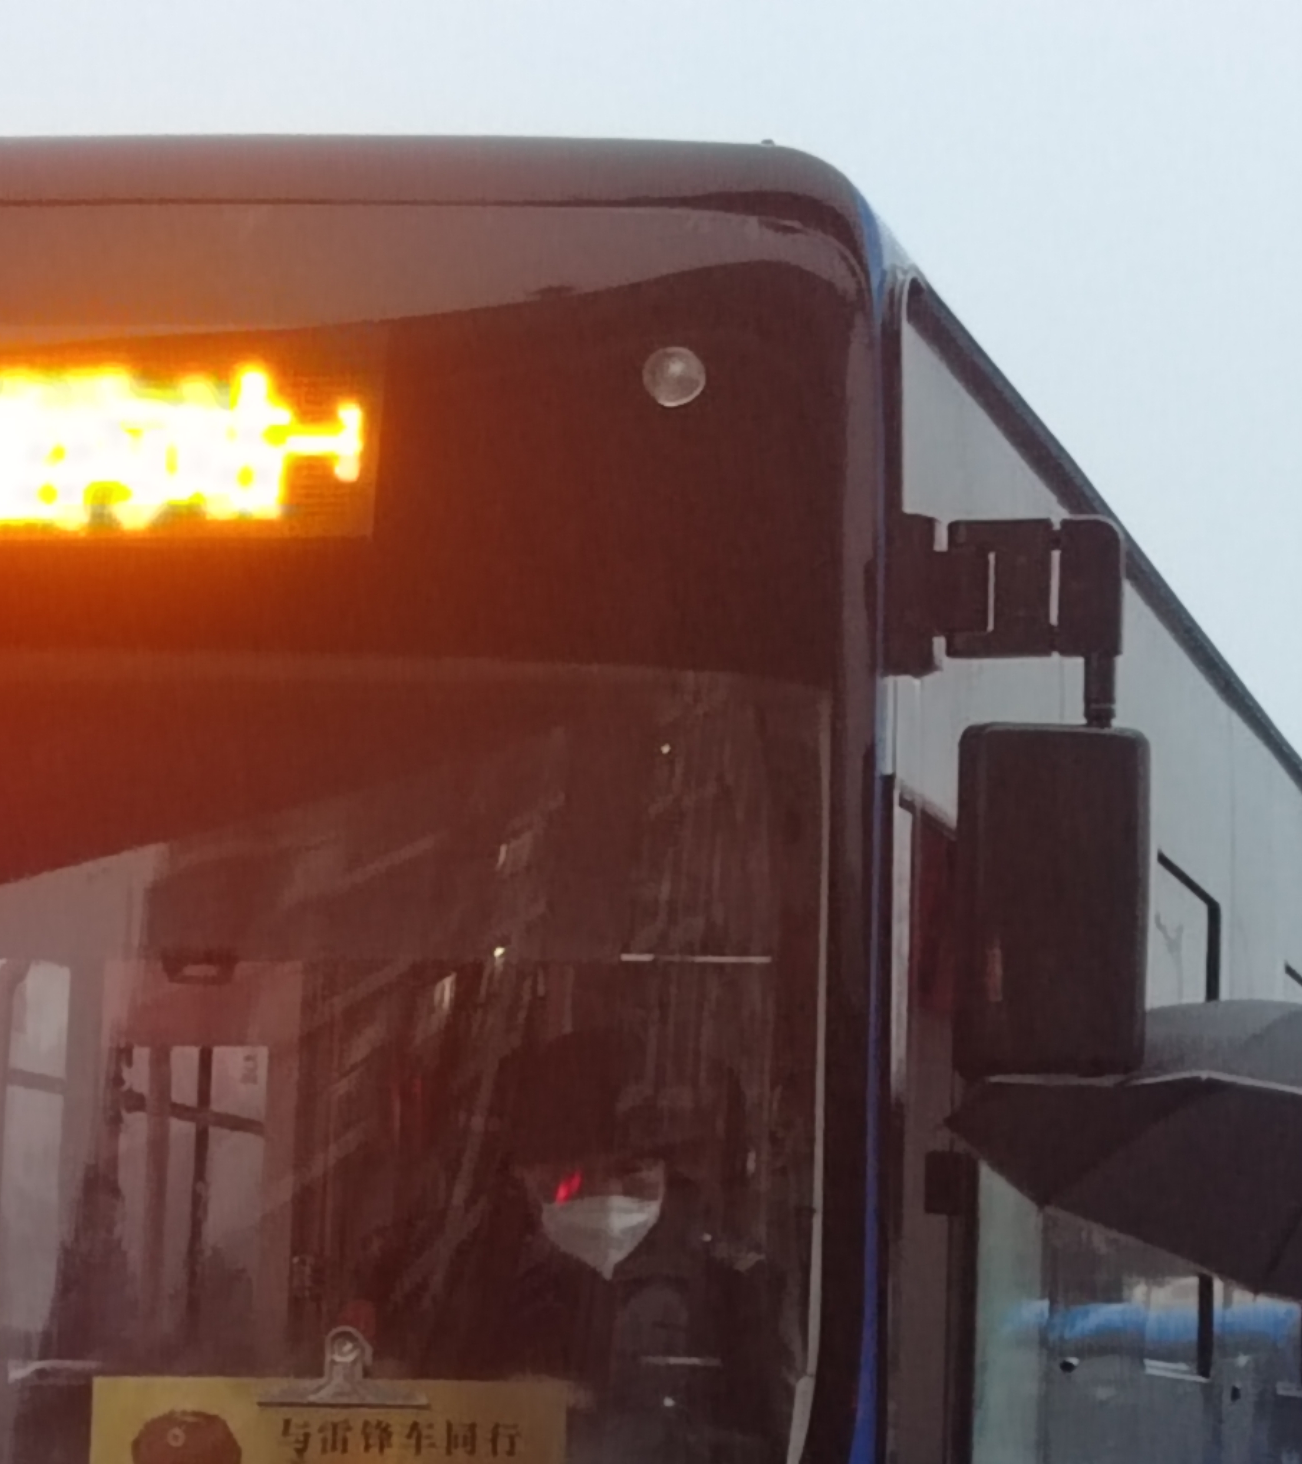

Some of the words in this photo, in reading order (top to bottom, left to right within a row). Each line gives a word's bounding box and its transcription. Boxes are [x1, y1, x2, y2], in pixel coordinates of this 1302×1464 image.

[277, 1417, 523, 1458] 与雷锋车同行
